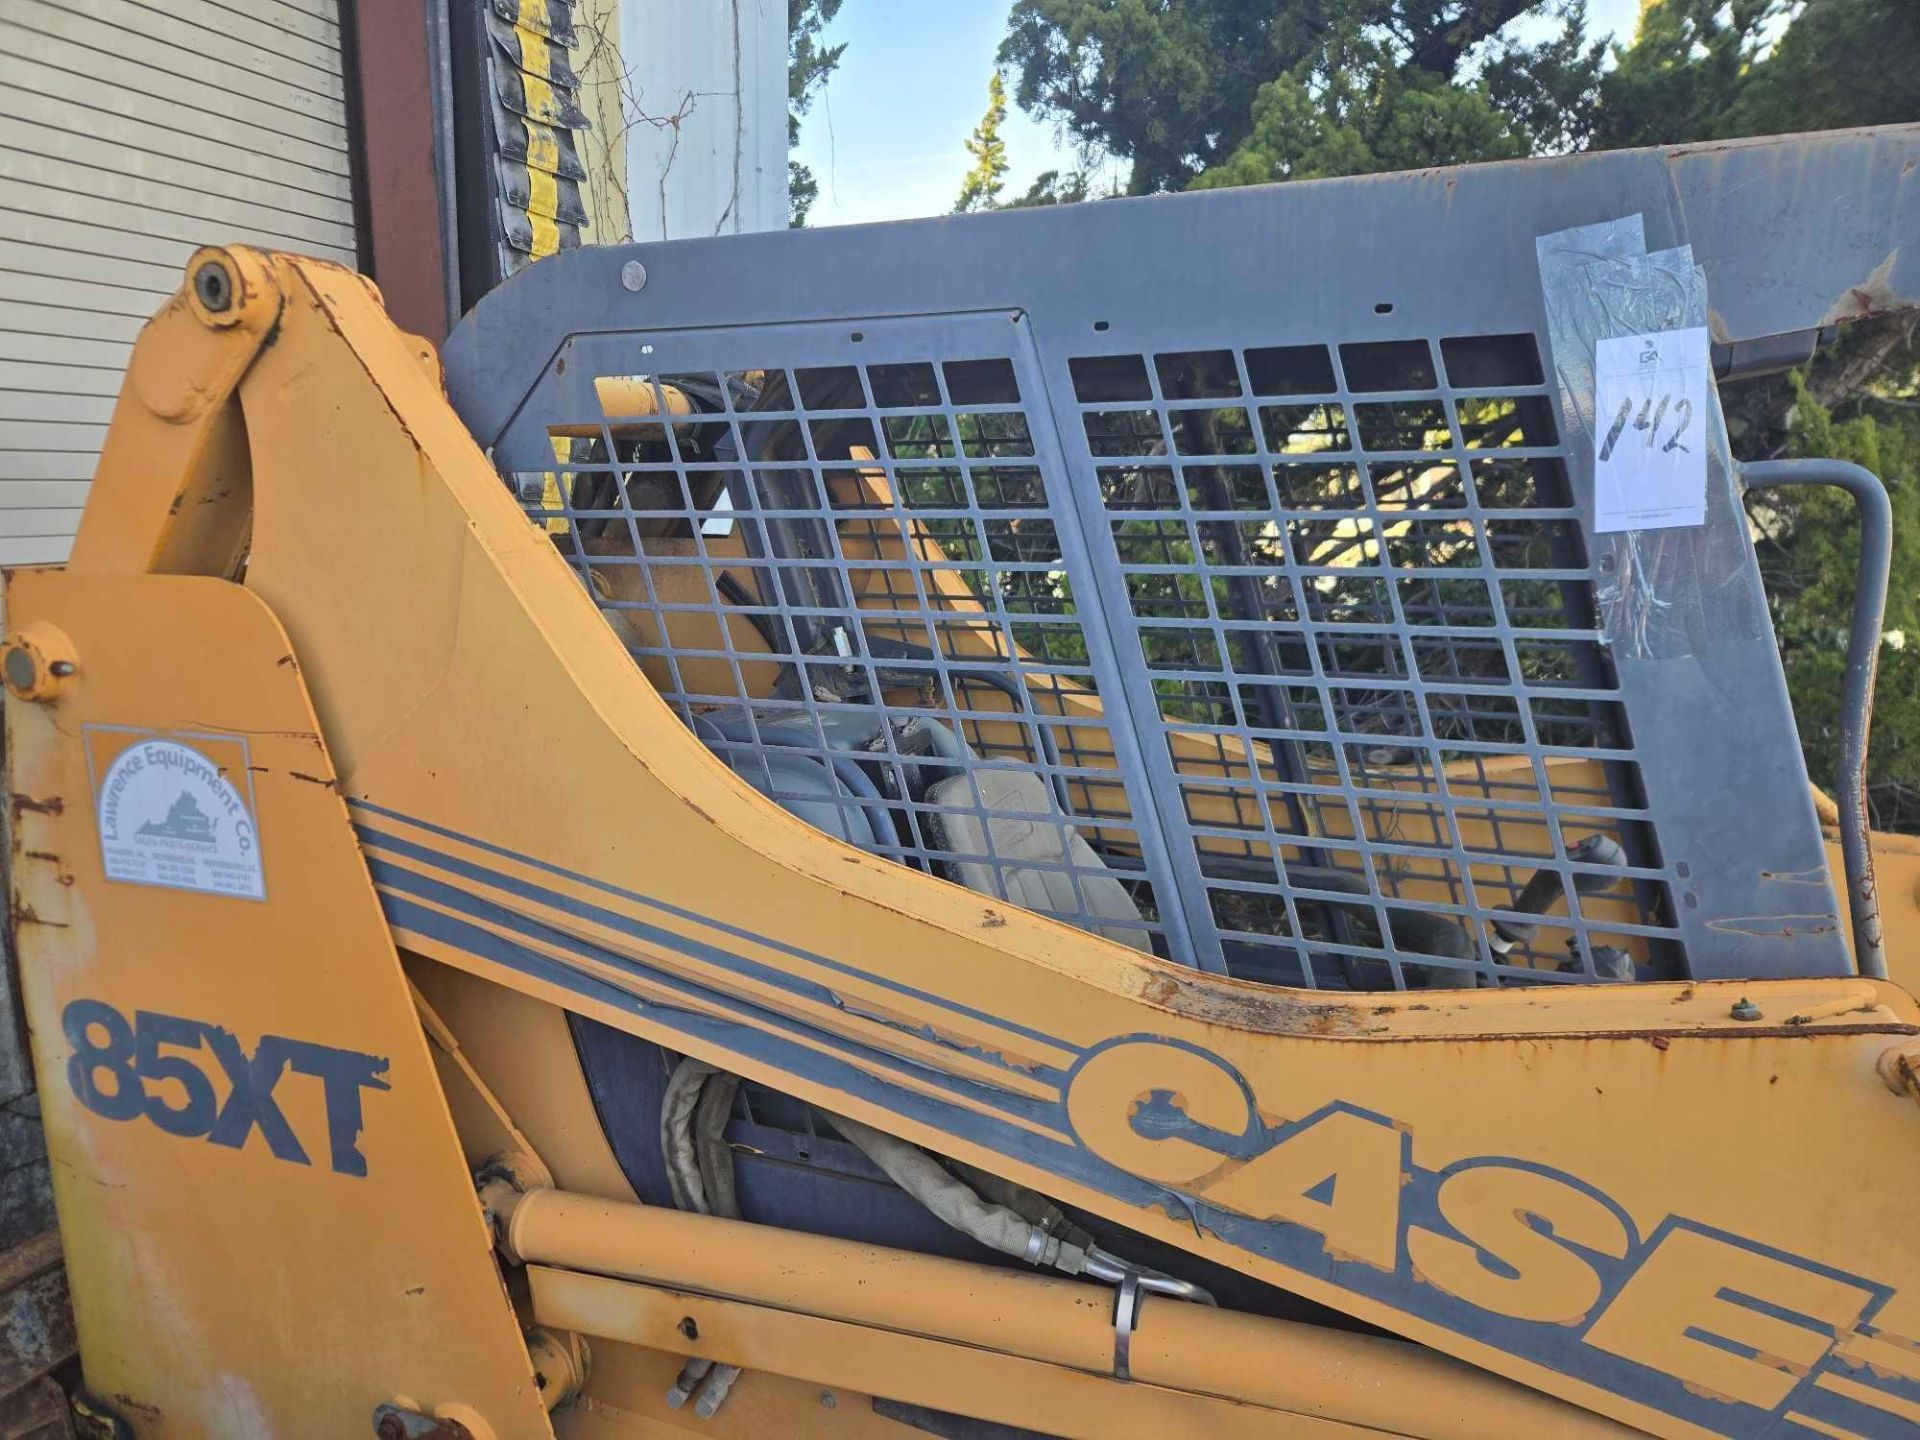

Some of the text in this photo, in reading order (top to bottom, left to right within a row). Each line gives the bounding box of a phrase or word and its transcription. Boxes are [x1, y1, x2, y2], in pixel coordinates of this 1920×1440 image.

[1598, 394, 1693, 461] 142
[104, 746, 251, 856] Lawrence Equipment Co.
[61, 998, 391, 1178] 85XT
[1066, 1036, 1882, 1410] CASE
